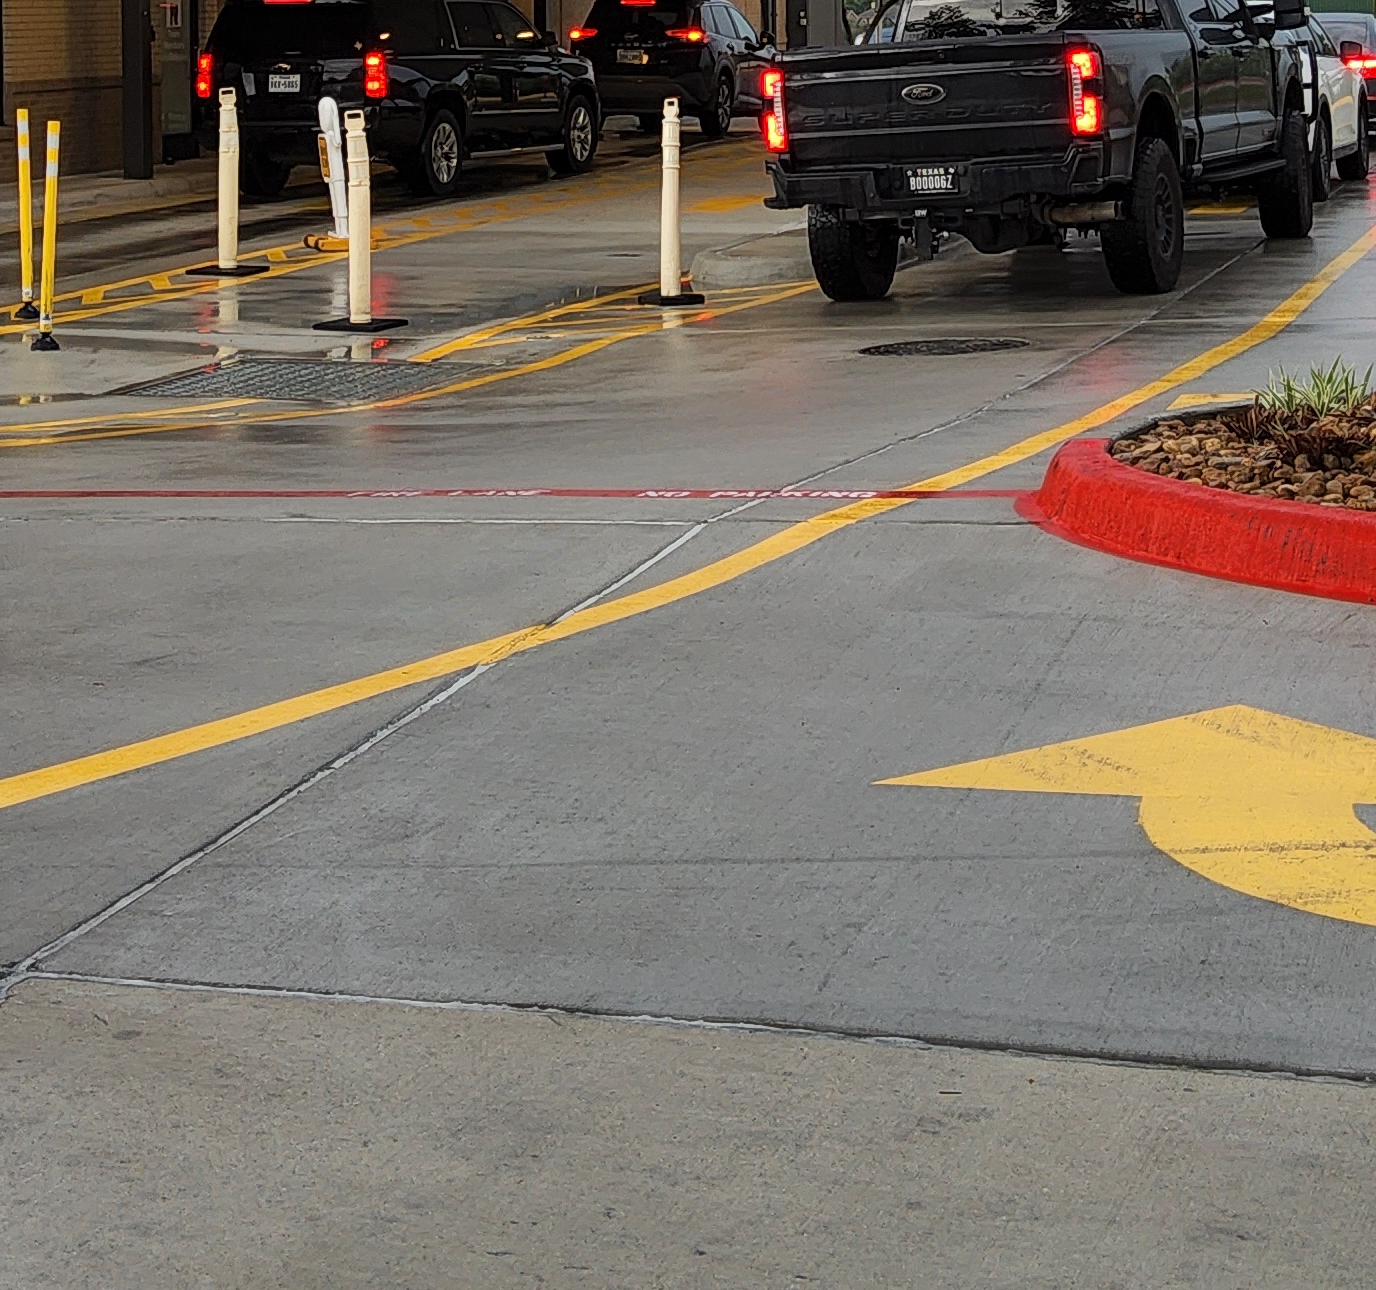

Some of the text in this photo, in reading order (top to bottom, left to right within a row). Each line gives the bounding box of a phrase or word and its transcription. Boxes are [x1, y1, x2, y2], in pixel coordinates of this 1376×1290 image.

[802, 102, 1052, 127] SUPER DUTY
[917, 168, 945, 176] TEXAS
[636, 490, 691, 498] NO
[708, 490, 877, 499] PARKING
